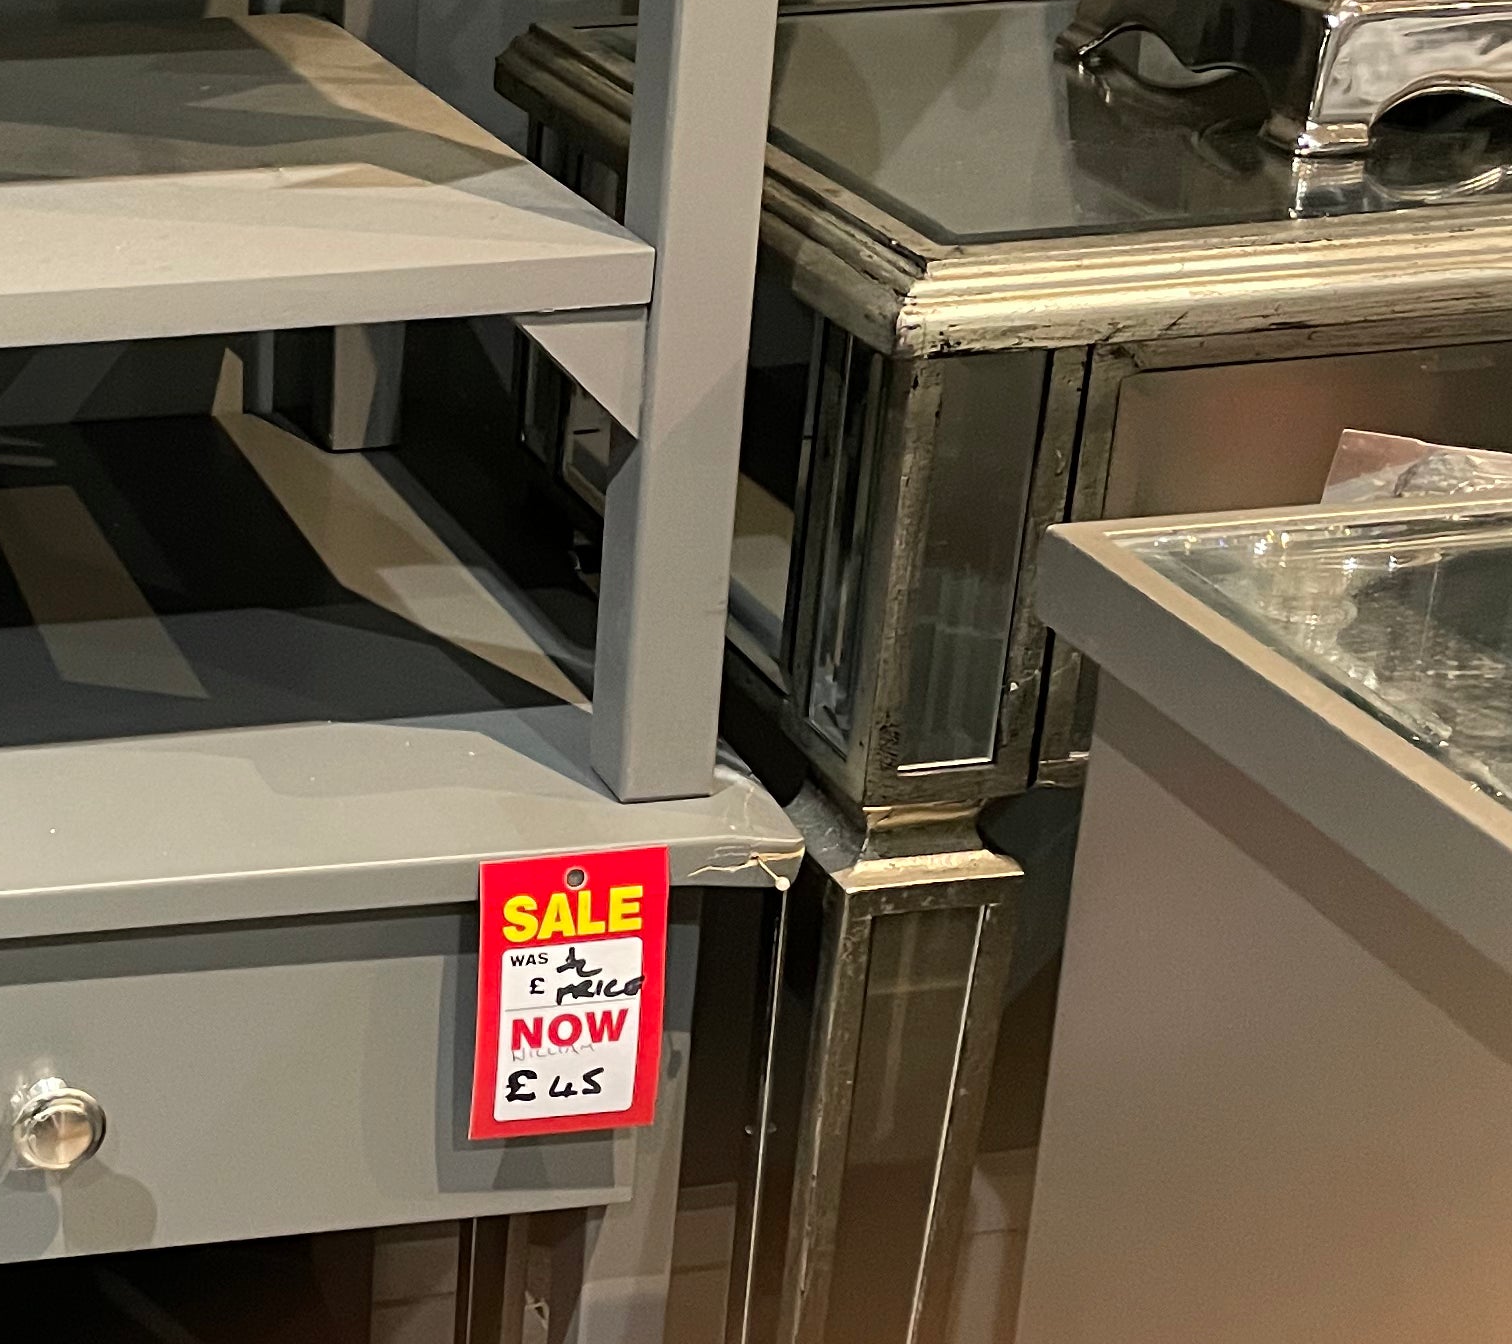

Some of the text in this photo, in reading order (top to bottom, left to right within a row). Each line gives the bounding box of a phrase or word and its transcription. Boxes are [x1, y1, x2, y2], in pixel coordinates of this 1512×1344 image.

[502, 885, 644, 943] SALE
[510, 952, 549, 967] WAS
[529, 977, 545, 995] £
[511, 1008, 629, 1051] NOW
